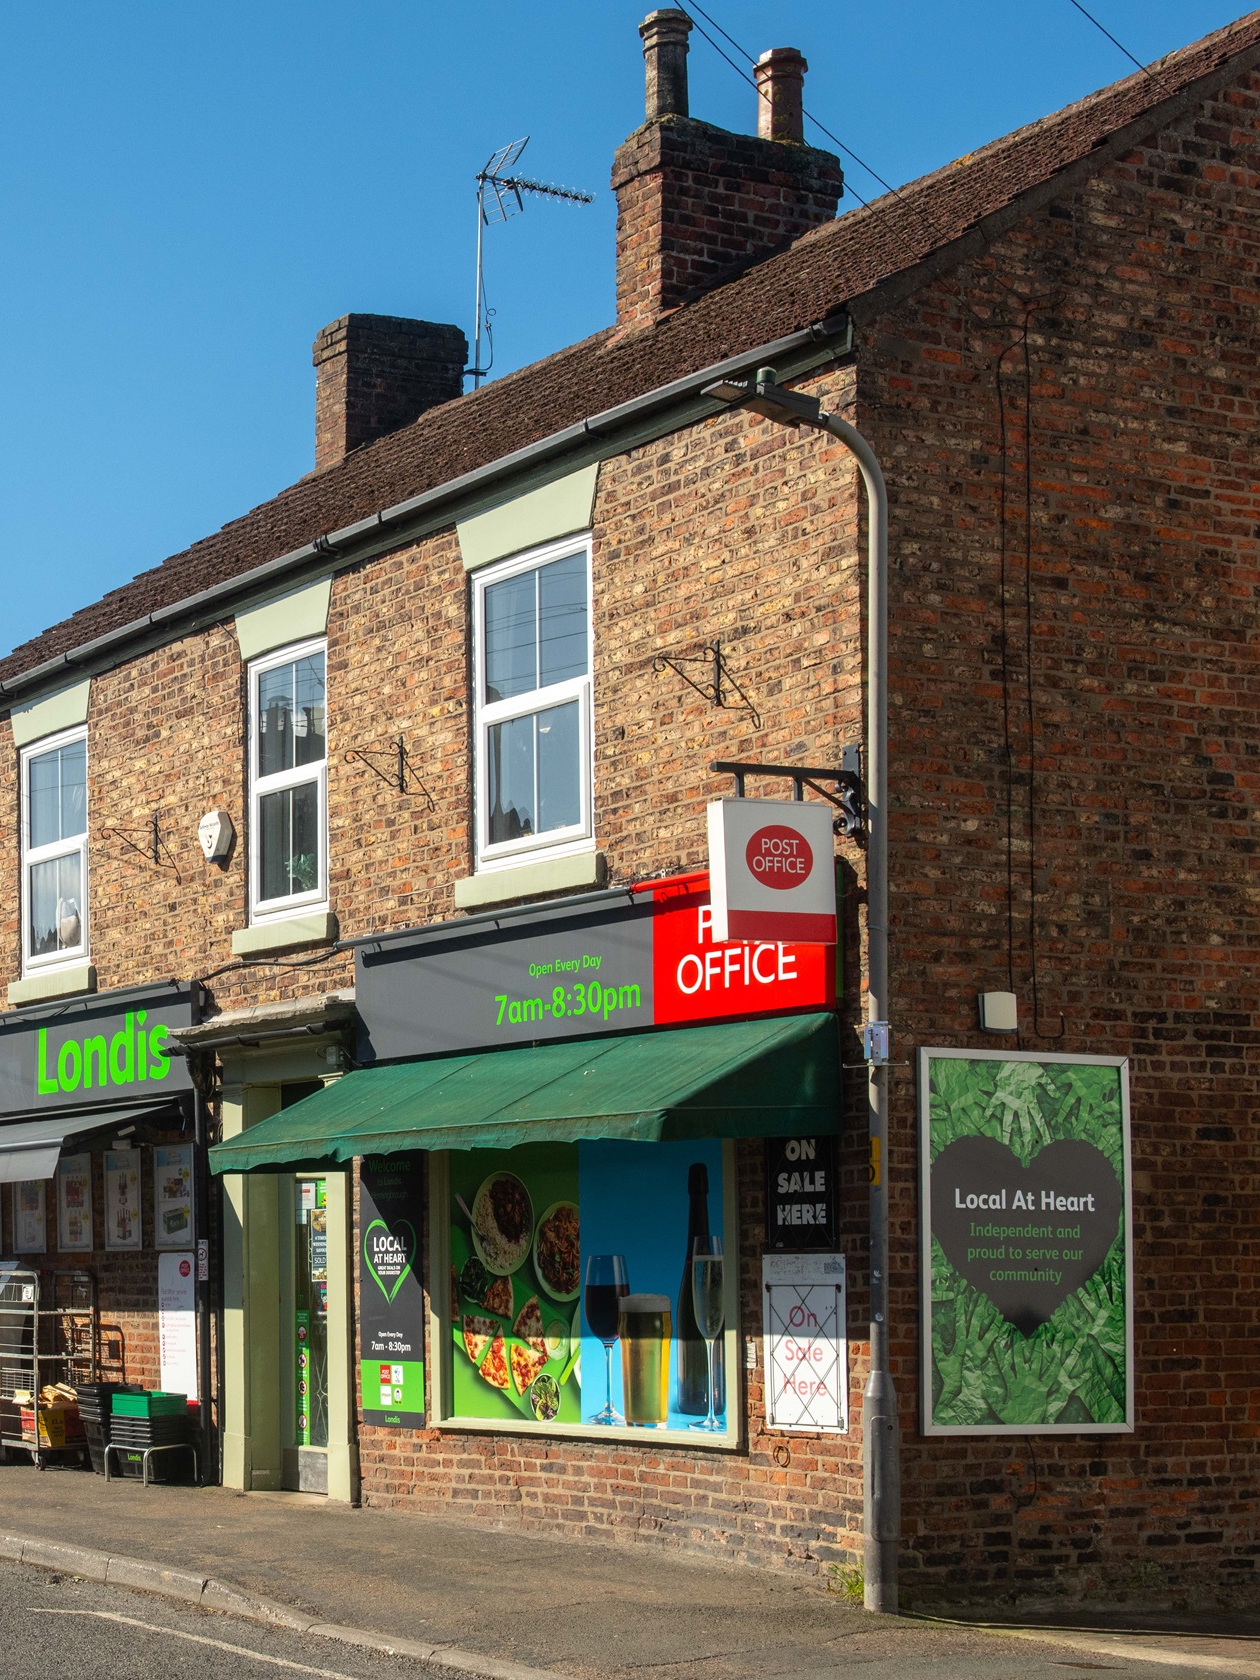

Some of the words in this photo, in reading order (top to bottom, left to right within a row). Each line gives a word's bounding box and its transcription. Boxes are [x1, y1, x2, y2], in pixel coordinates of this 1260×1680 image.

[761, 838, 799, 855] POST
[752, 856, 805, 874] OFFICE
[528, 963, 553, 979] Open
[555, 959, 580, 973] Every
[582, 954, 602, 970] Day
[677, 941, 797, 994] OFFICE
[494, 980, 641, 1026] 7am-8:30pm
[38, 1007, 171, 1095] Londis
[785, 1138, 816, 1161] ON
[368, 1159, 411, 1173] Welcome
[777, 1170, 826, 1194] SALE
[955, 1188, 1006, 1209] Local
[1012, 1190, 1035, 1210] At
[1041, 1190, 1095, 1211] Heart
[777, 1203, 827, 1226] HERE
[970, 1222, 1053, 1240] Independent
[1056, 1225, 1080, 1238] and
[373, 1236, 407, 1251] LOCAL
[967, 1245, 1005, 1262] proud
[1009, 1246, 1022, 1259] to
[1026, 1249, 1059, 1260] serve
[1062, 1249, 1083, 1260] our
[373, 1253, 383, 1263] AT
[383, 1253, 406, 1263] HEART
[989, 1268, 1062, 1285] community
[789, 1305, 817, 1328] On
[378, 1331, 386, 1339] Open
[371, 1341, 384, 1351] 7am
[388, 1341, 411, 1354] 8:30pm
[785, 1339, 823, 1362] Sale
[783, 1374, 827, 1397] Here
[385, 1414, 400, 1423] Londis
